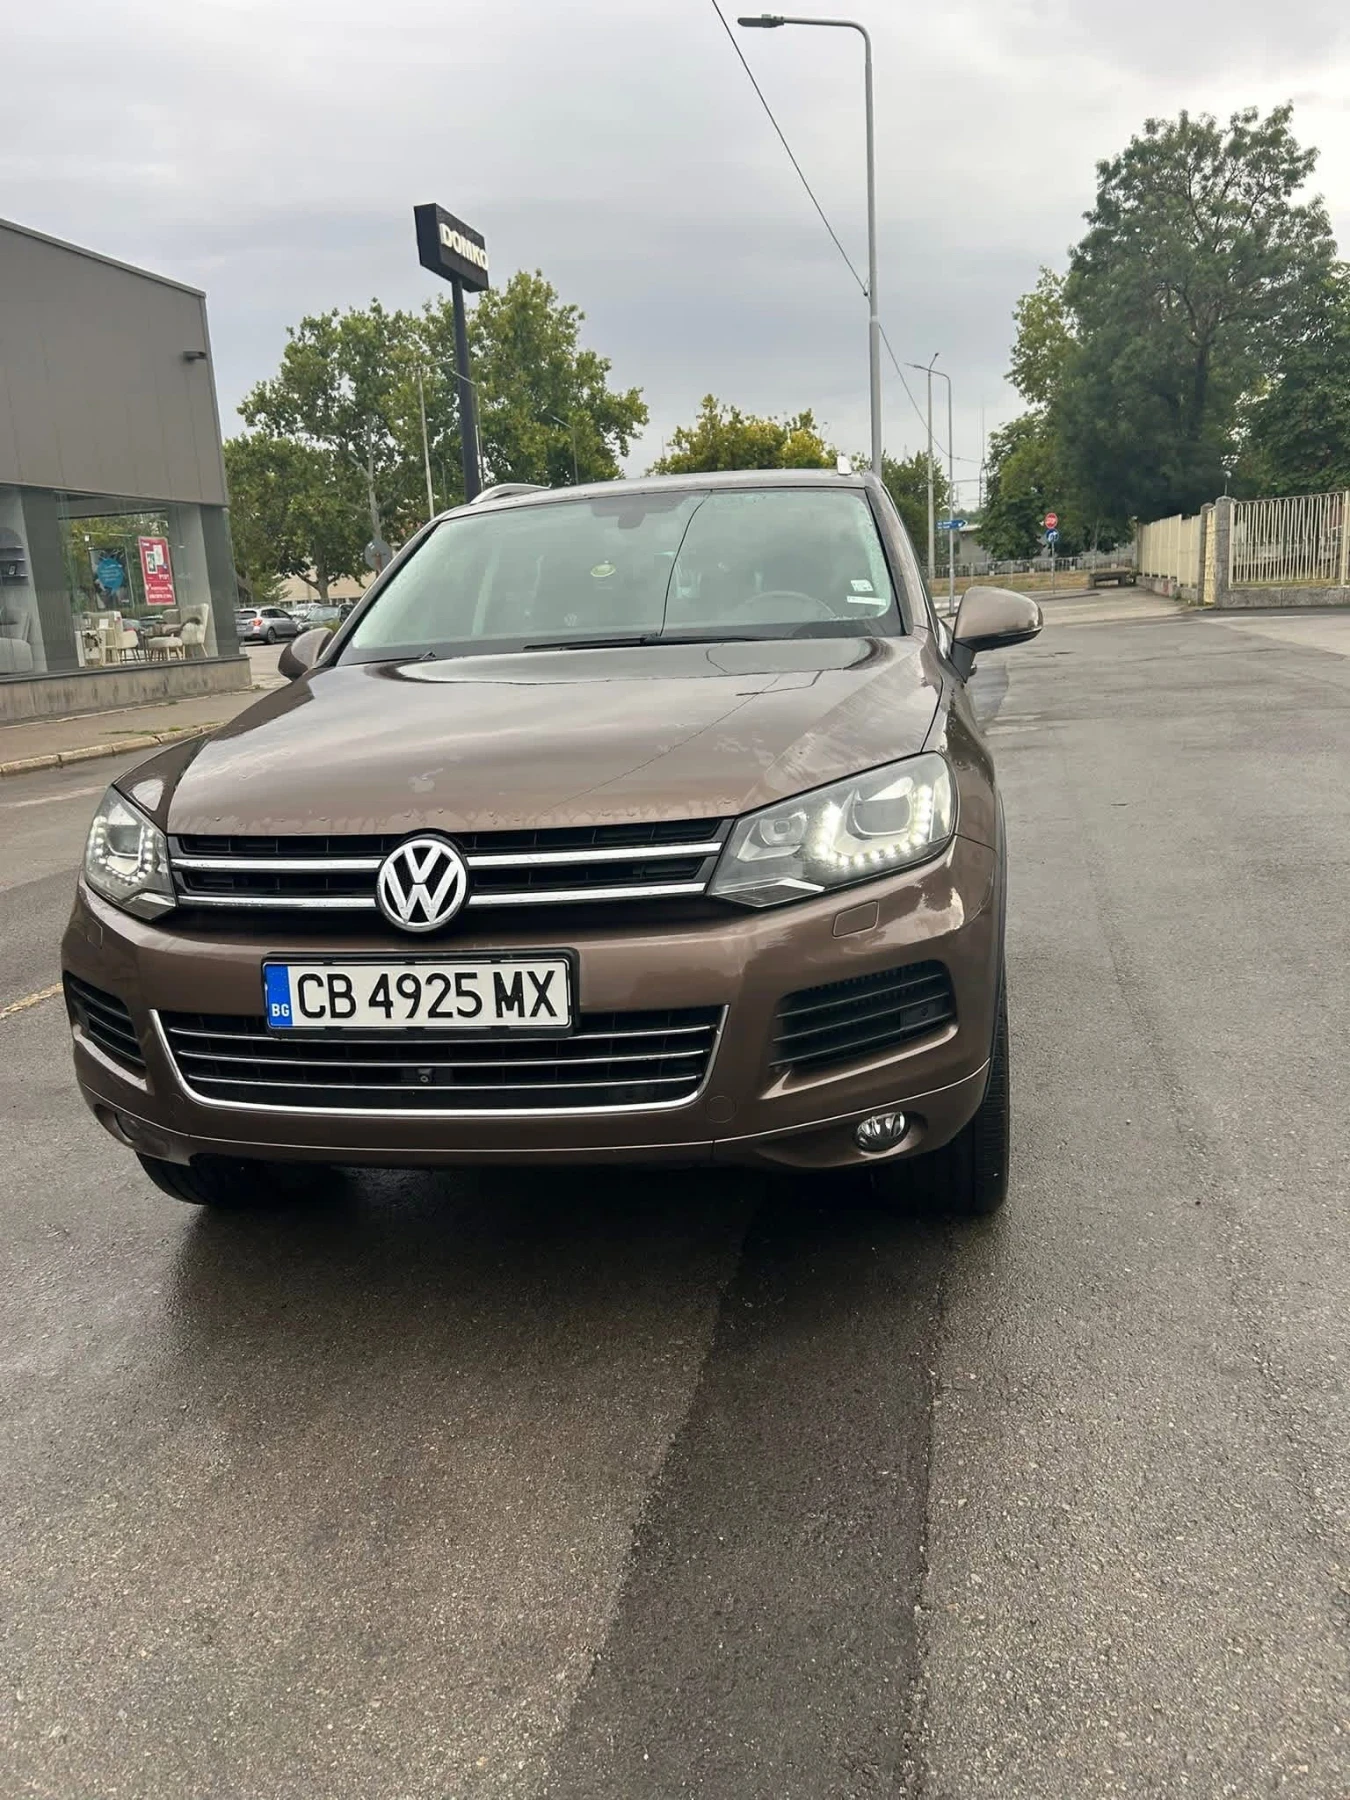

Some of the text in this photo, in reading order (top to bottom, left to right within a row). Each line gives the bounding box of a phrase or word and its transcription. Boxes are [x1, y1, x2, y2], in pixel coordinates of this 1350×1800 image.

[439, 222, 489, 271] DOMKO
[382, 840, 463, 925] VW
[271, 1003, 290, 1017] BG
[297, 970, 558, 1019] CB 4925 MX
